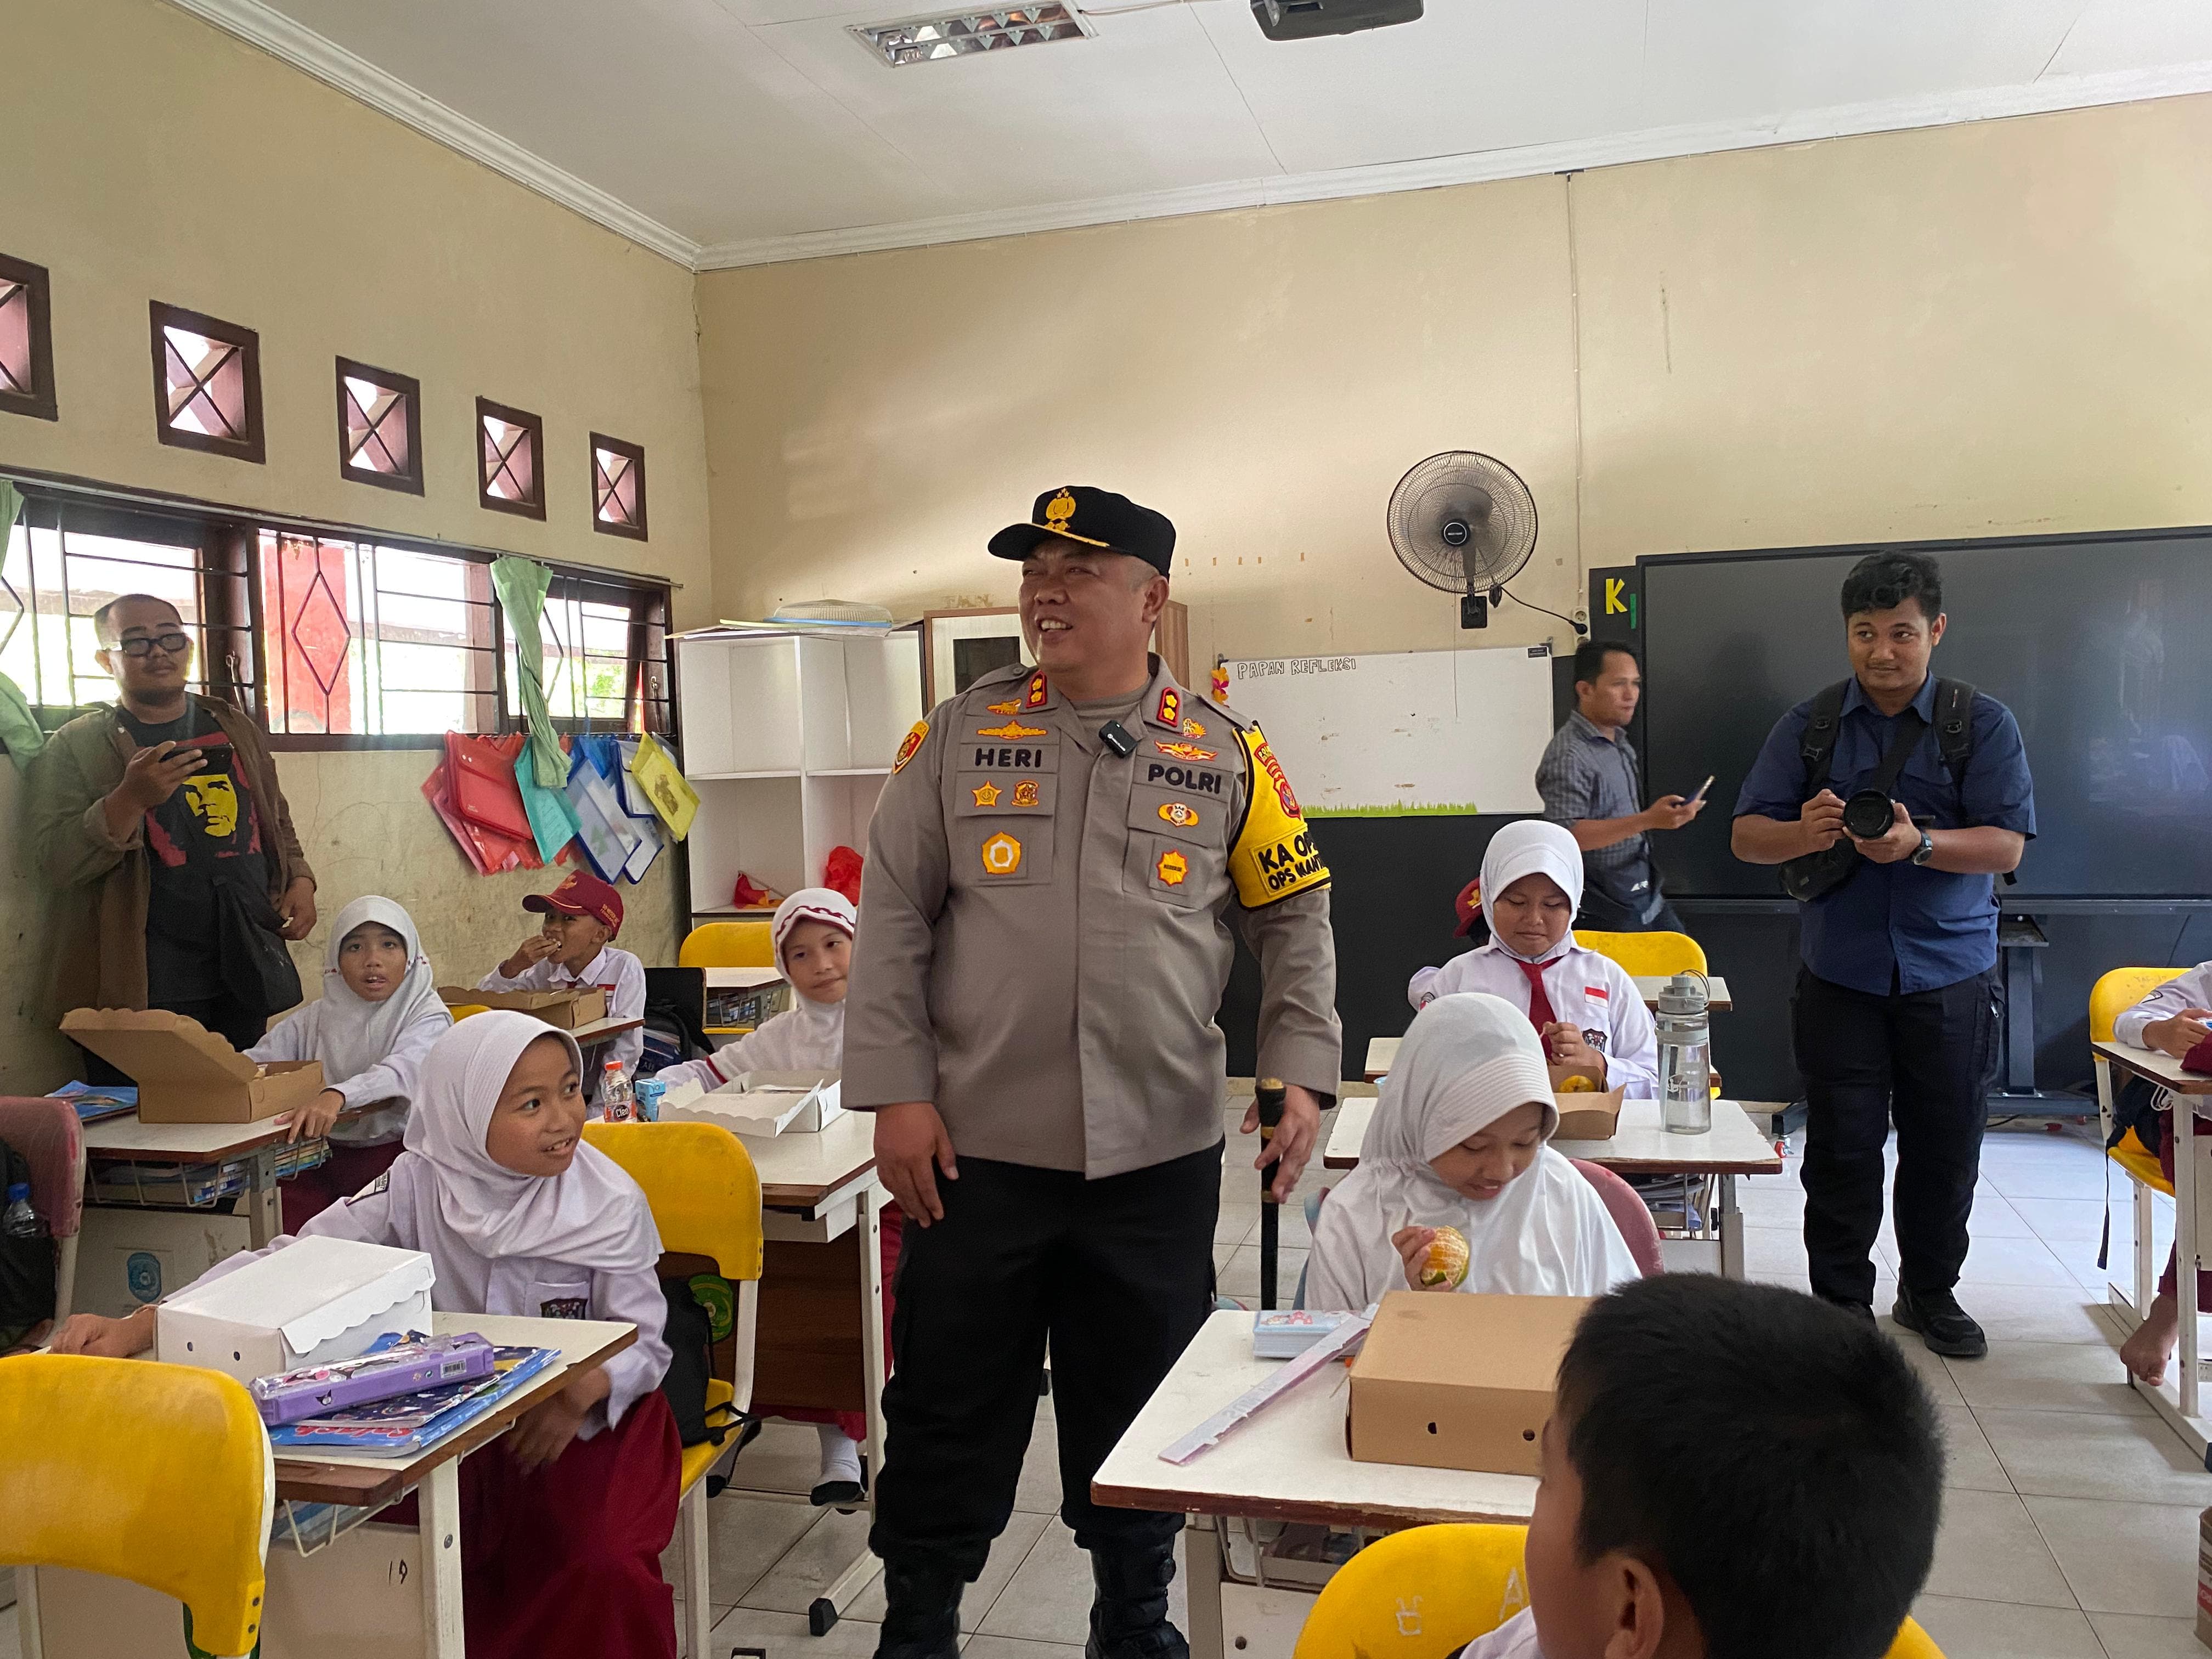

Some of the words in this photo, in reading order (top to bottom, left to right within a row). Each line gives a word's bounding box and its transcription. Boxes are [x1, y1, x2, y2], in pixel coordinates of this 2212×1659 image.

[1237, 661, 1284, 679] PAPAN
[1291, 657, 1356, 675] REFLEKSI
[975, 748, 1042, 768] HERI
[1148, 764, 1221, 794] POLRI
[1258, 843, 1295, 873] KA
[1268, 867, 1296, 890] OPS
[616, 1107, 629, 1118] Cleo
